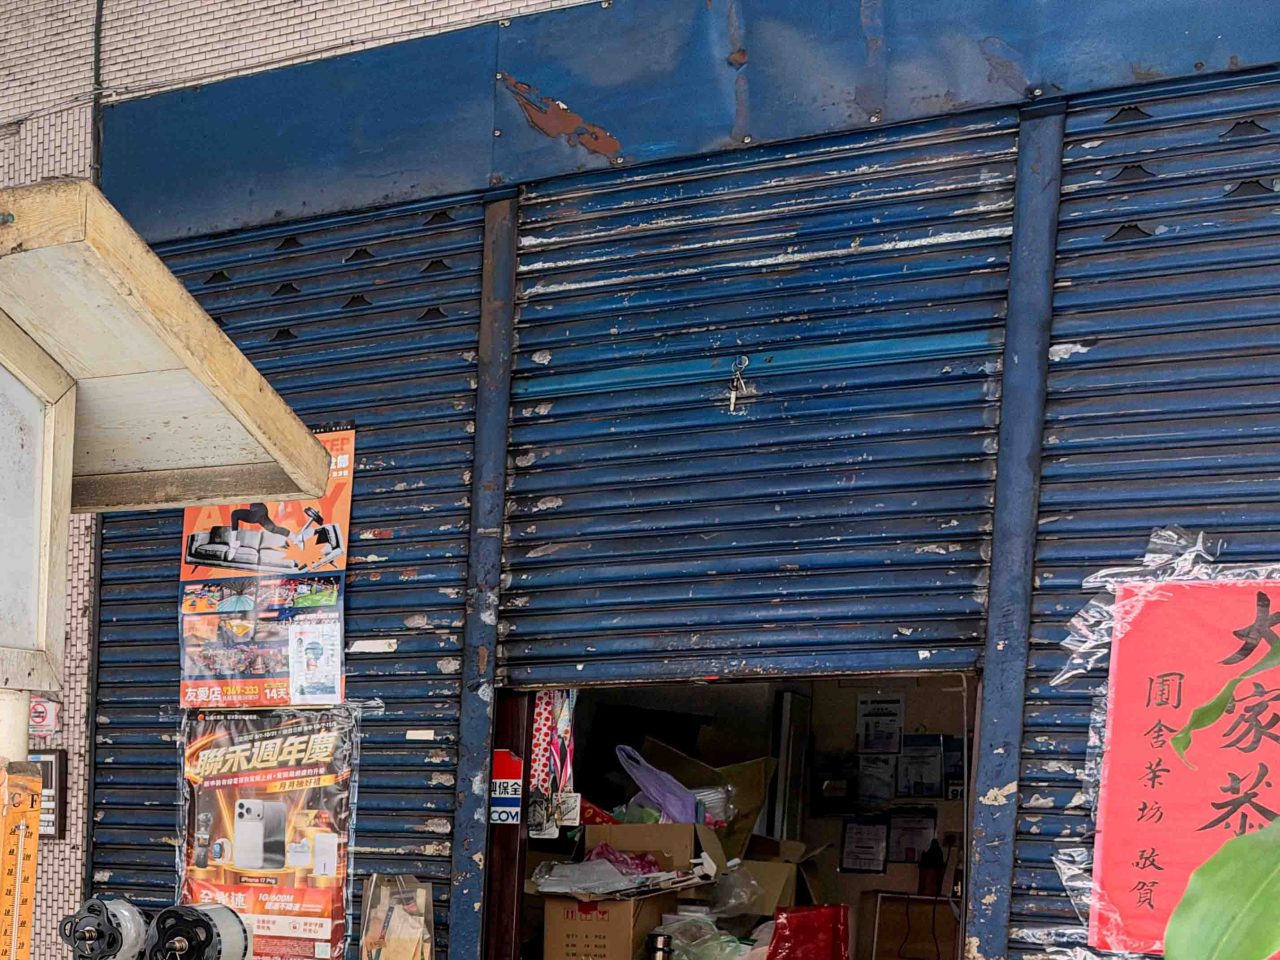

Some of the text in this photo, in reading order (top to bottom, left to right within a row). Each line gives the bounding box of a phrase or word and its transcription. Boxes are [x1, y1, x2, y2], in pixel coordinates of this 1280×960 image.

[185, 687, 221, 702] 友愛店
[196, 729, 339, 777] 聯禾週年慶
[29, 793, 40, 809] F
[1131, 848, 1165, 910] 敬賀
